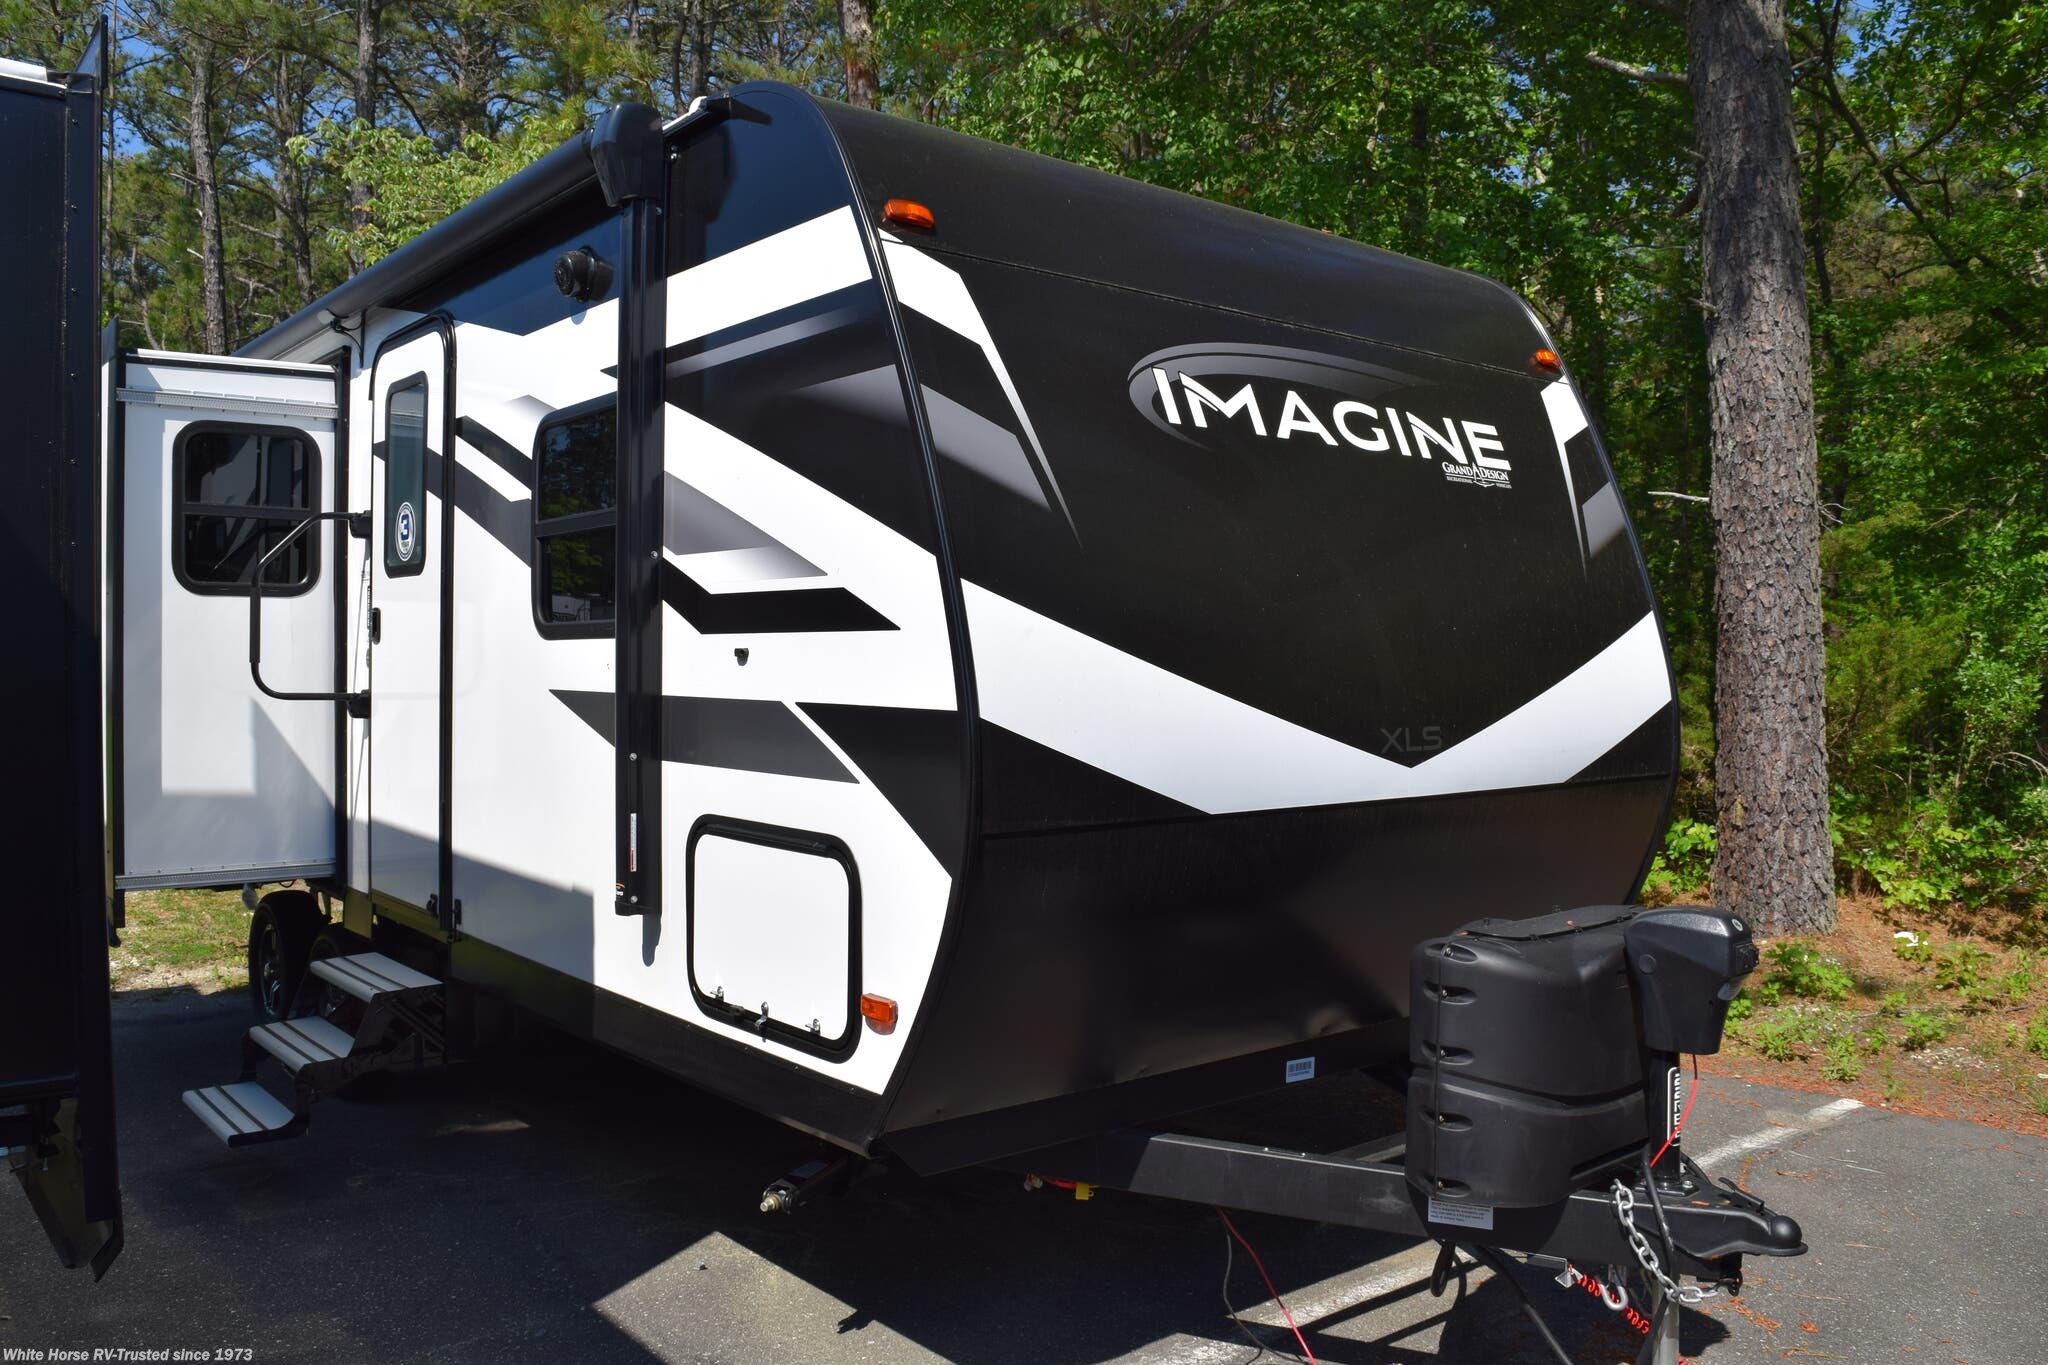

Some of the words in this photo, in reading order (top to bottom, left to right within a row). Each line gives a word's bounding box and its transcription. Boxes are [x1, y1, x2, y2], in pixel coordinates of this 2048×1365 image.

[1152, 367, 1512, 471] IMAGINE
[1442, 461, 1474, 476] GRAND
[1478, 466, 1510, 481] DESIGN
[400, 513, 410, 541] 3
[1380, 725, 1443, 753] XLS
